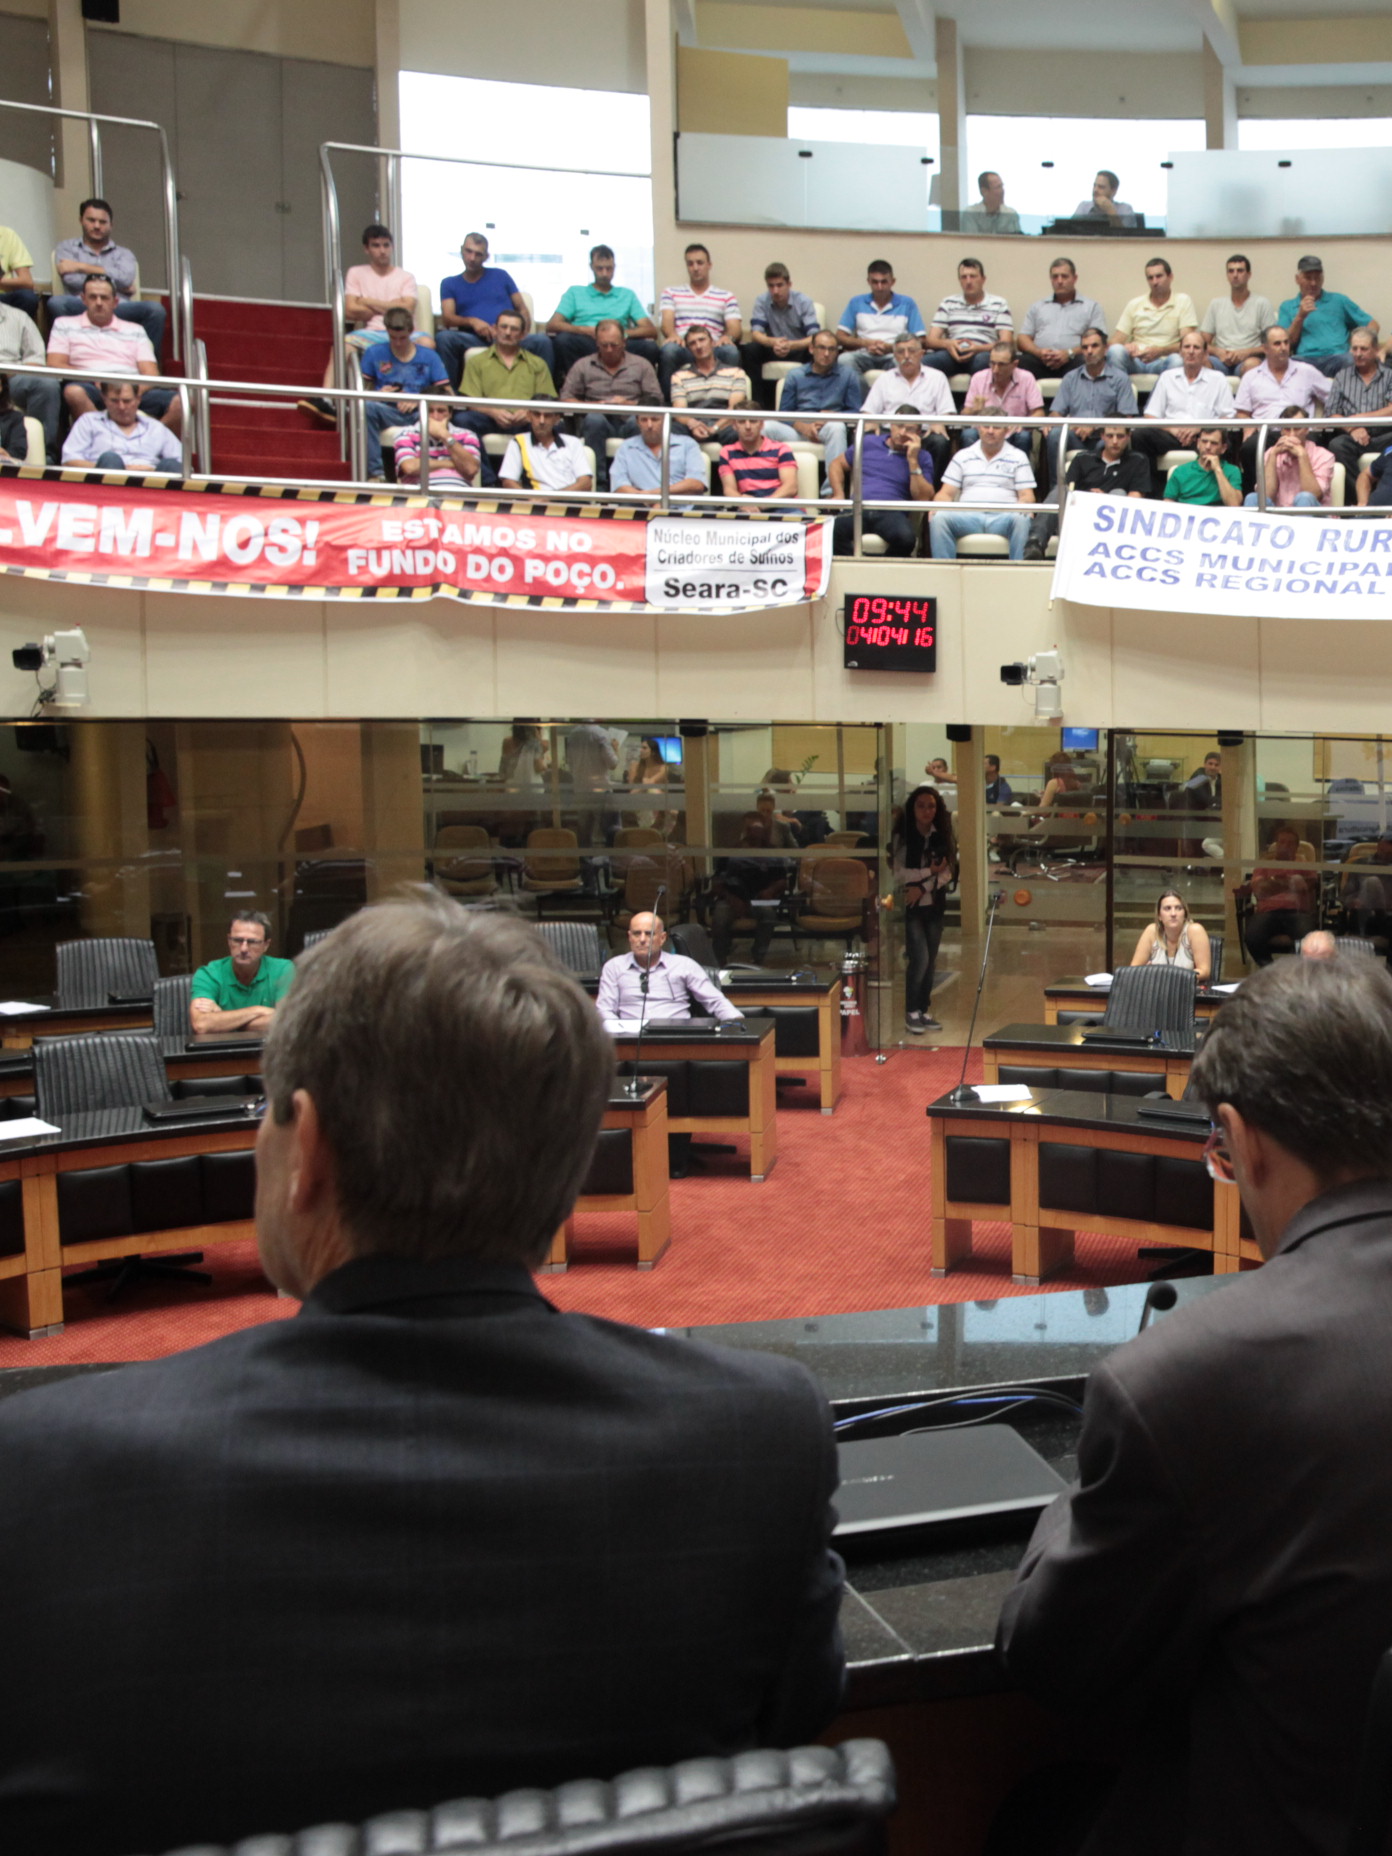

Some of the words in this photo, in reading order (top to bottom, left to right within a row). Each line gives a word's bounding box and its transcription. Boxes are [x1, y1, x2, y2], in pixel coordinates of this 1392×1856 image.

[0, 500, 320, 566] VEM-NOS!
[381, 518, 537, 550] ESTAMOS
[546, 531, 593, 552] NO
[653, 528, 701, 546] Núcleo
[706, 530, 772, 547] Municipal
[775, 531, 799, 545] dos
[1093, 504, 1296, 550] SINDICATO
[657, 549, 723, 565] Criadores
[729, 550, 745, 565] de
[1087, 541, 1185, 566] ACCS
[347, 549, 457, 575] FUNDO
[466, 554, 514, 583] DO
[525, 559, 625, 594] POÇO.
[1083, 561, 1181, 585] ACCS
[1195, 572, 1387, 595] REGIONAL
[664, 577, 789, 599] Seara-SC
[852, 597, 929, 624] 09:44
